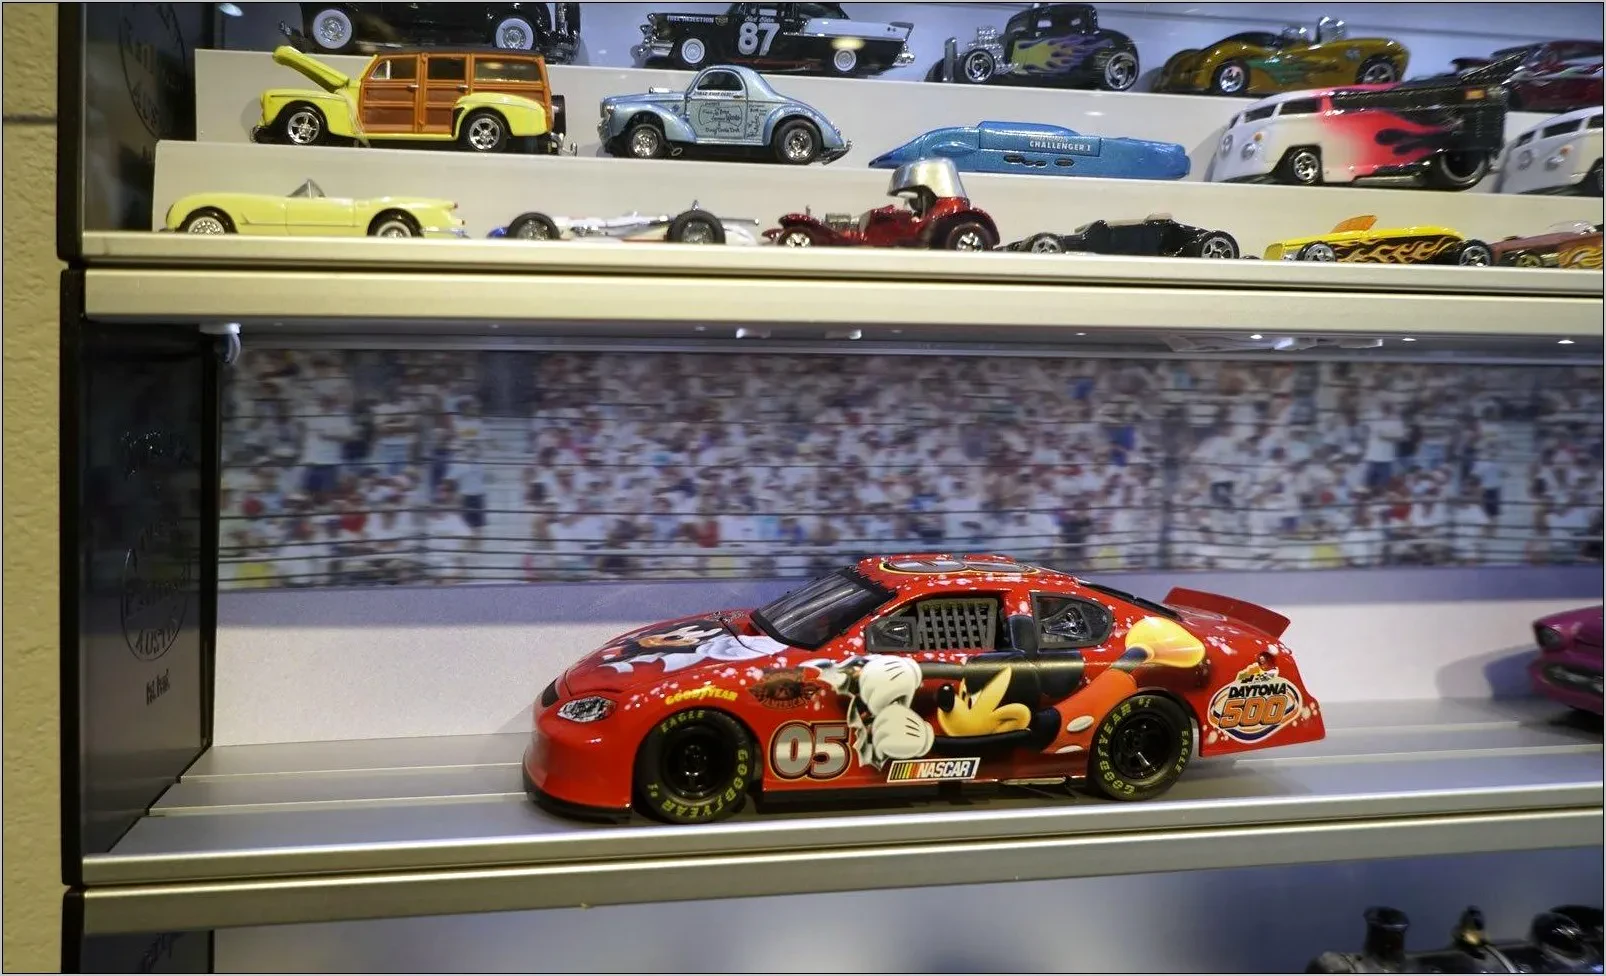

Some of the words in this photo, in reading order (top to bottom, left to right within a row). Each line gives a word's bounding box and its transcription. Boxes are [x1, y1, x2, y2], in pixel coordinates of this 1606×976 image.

[738, 22, 780, 56] 87
[1029, 140, 1085, 151] CHALLENGER
[665, 685, 739, 705] GOODYEAR
[1228, 682, 1287, 699] DAYTONA
[661, 709, 706, 734] EAGLE
[1219, 694, 1289, 728] 500
[768, 720, 852, 782] 05
[1097, 702, 1136, 796] GOODYEAR
[1174, 730, 1190, 774] EAGLE
[660, 748, 749, 819] GOODYEAR
[916, 760, 972, 779] NASCAR
